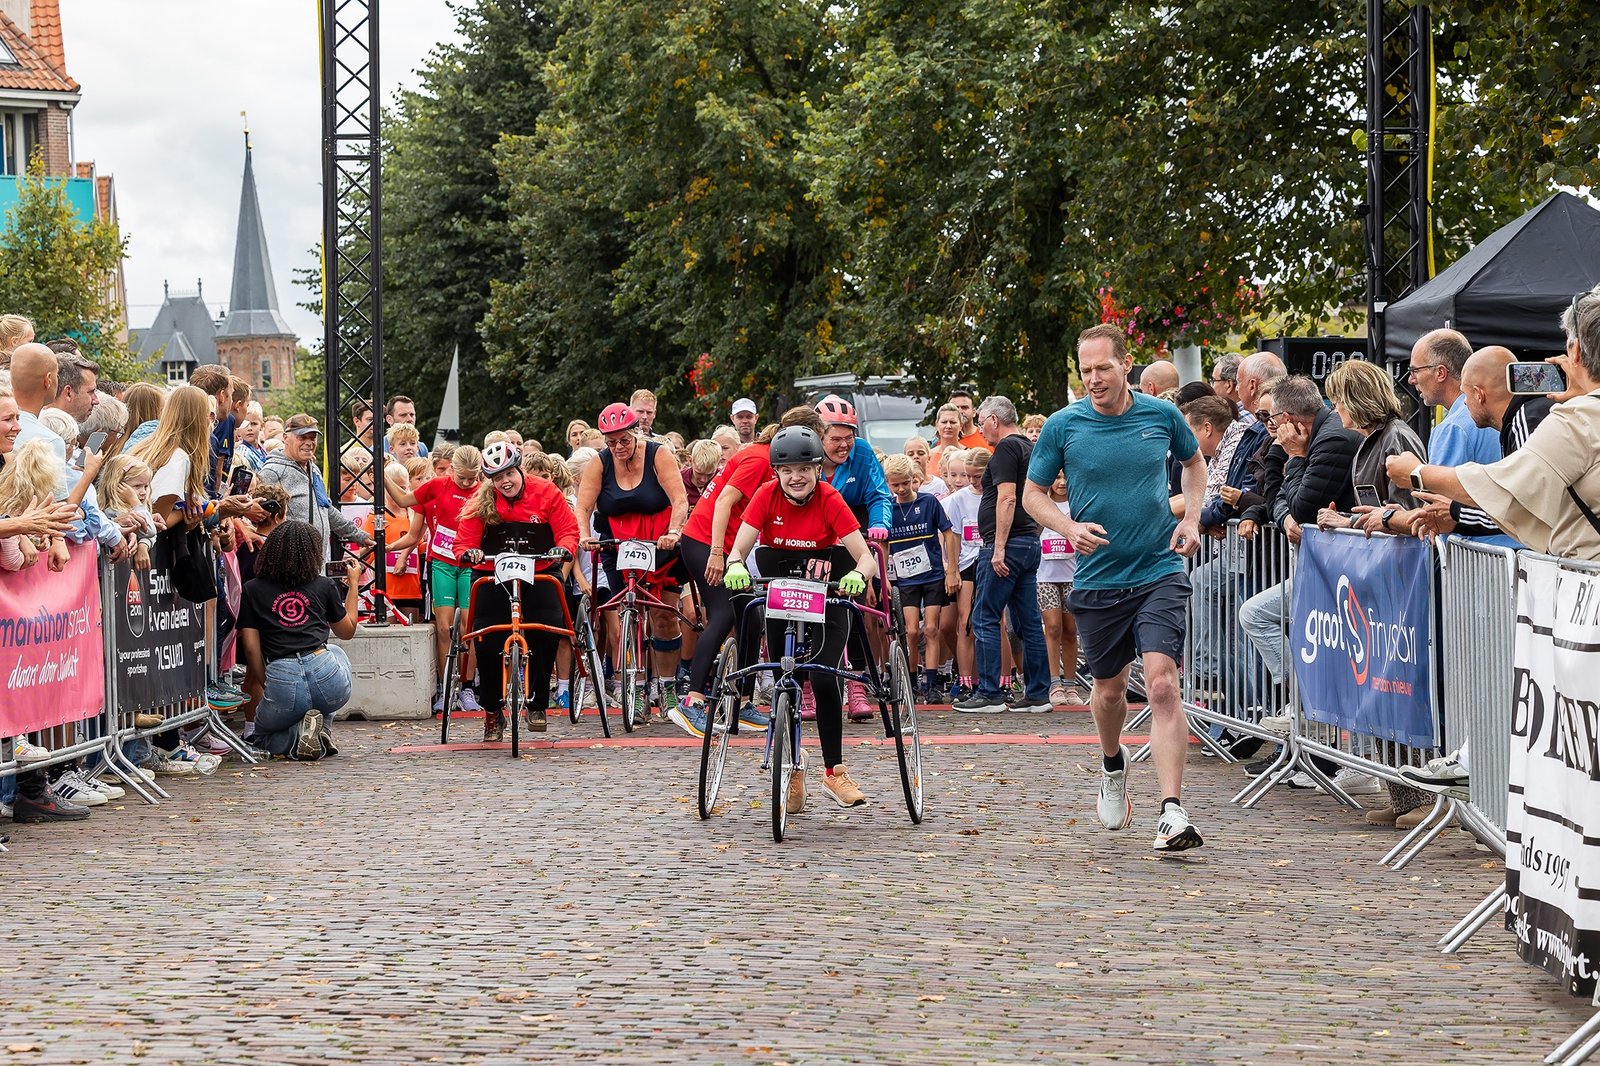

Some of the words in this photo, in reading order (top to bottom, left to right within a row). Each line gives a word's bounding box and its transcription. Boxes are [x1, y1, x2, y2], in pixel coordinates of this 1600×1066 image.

[773, 537, 784, 545] AV
[785, 538, 817, 548] HORROR
[624, 551, 647, 560] 7479
[501, 561, 527, 571] 7478
[900, 556, 922, 568] 7520
[780, 591, 814, 600] BENTHE
[271, 592, 295, 612] MARATHON
[783, 599, 810, 609] 2238
[153, 611, 170, 630] van
[1301, 607, 1345, 664] groot
